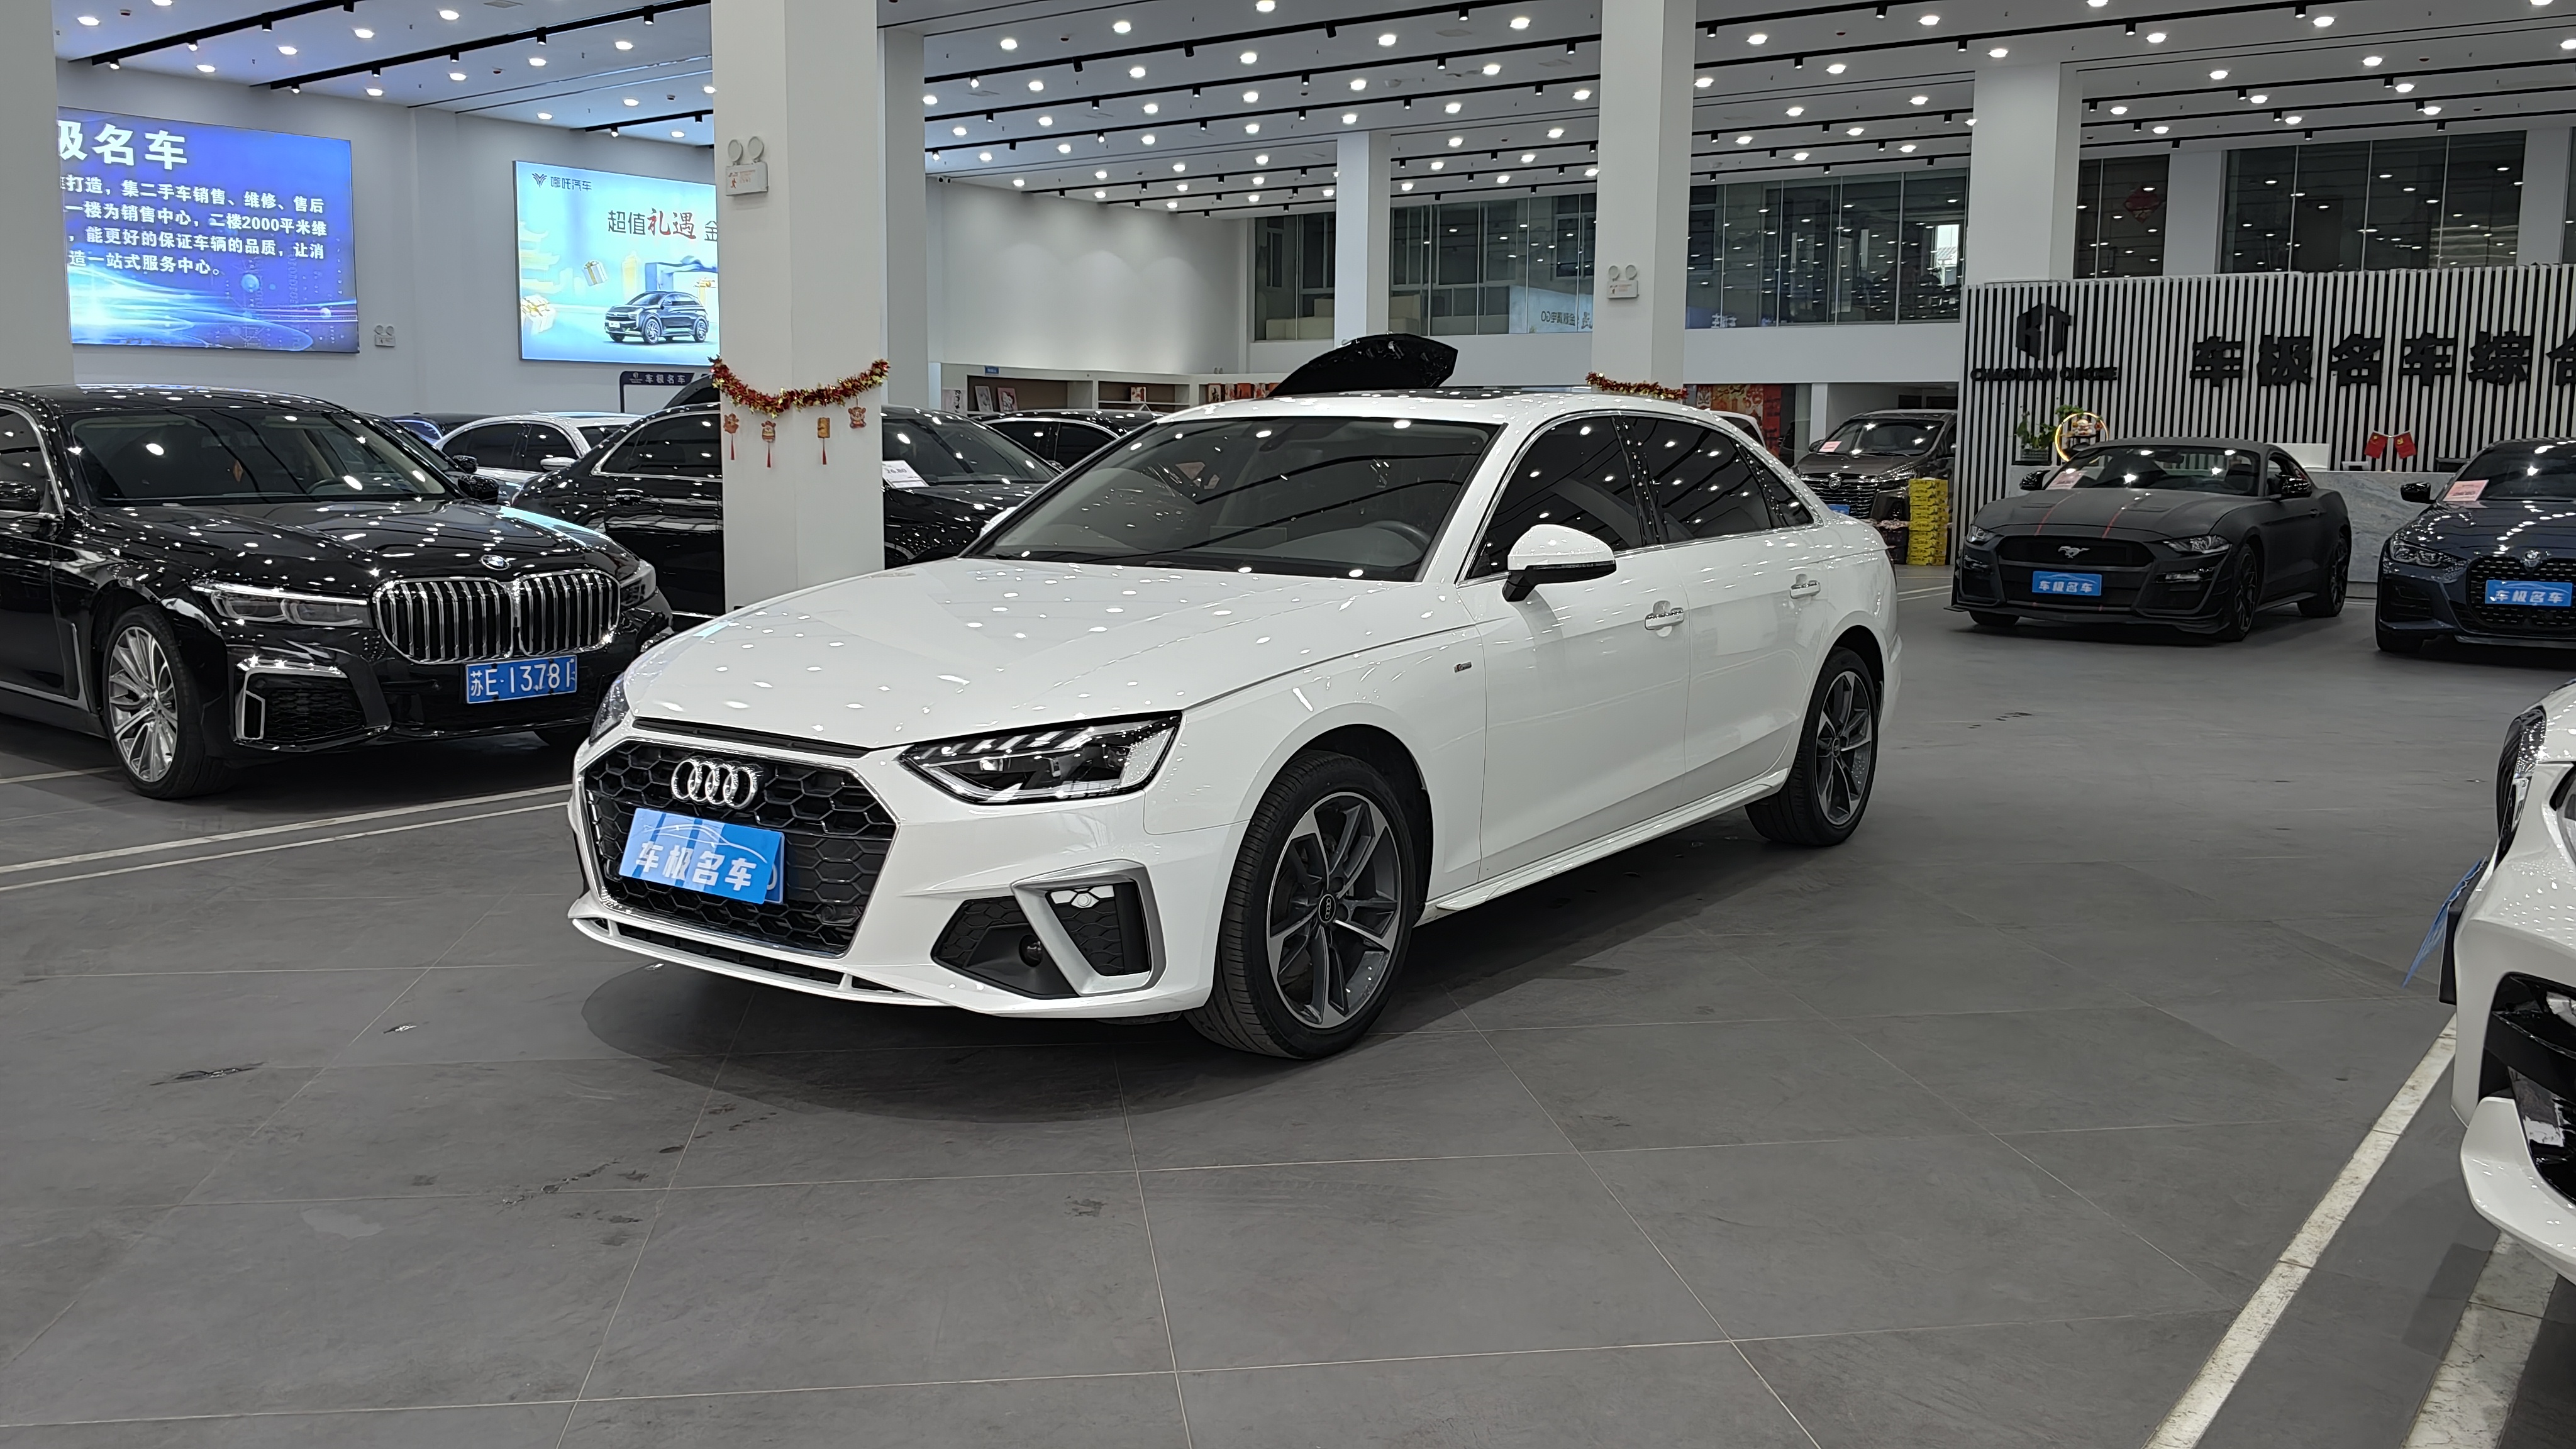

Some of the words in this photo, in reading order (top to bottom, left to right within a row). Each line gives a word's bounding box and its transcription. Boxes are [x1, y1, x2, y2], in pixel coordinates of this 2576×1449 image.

[60, 174, 325, 214] 打造，集二手车销售、维修、售后
[608, 207, 697, 240] 超值礼遇
[2038, 580, 2094, 592] 车极名车
[2495, 590, 2564, 604] 车极名车
[635, 841, 757, 891] 车极名车
